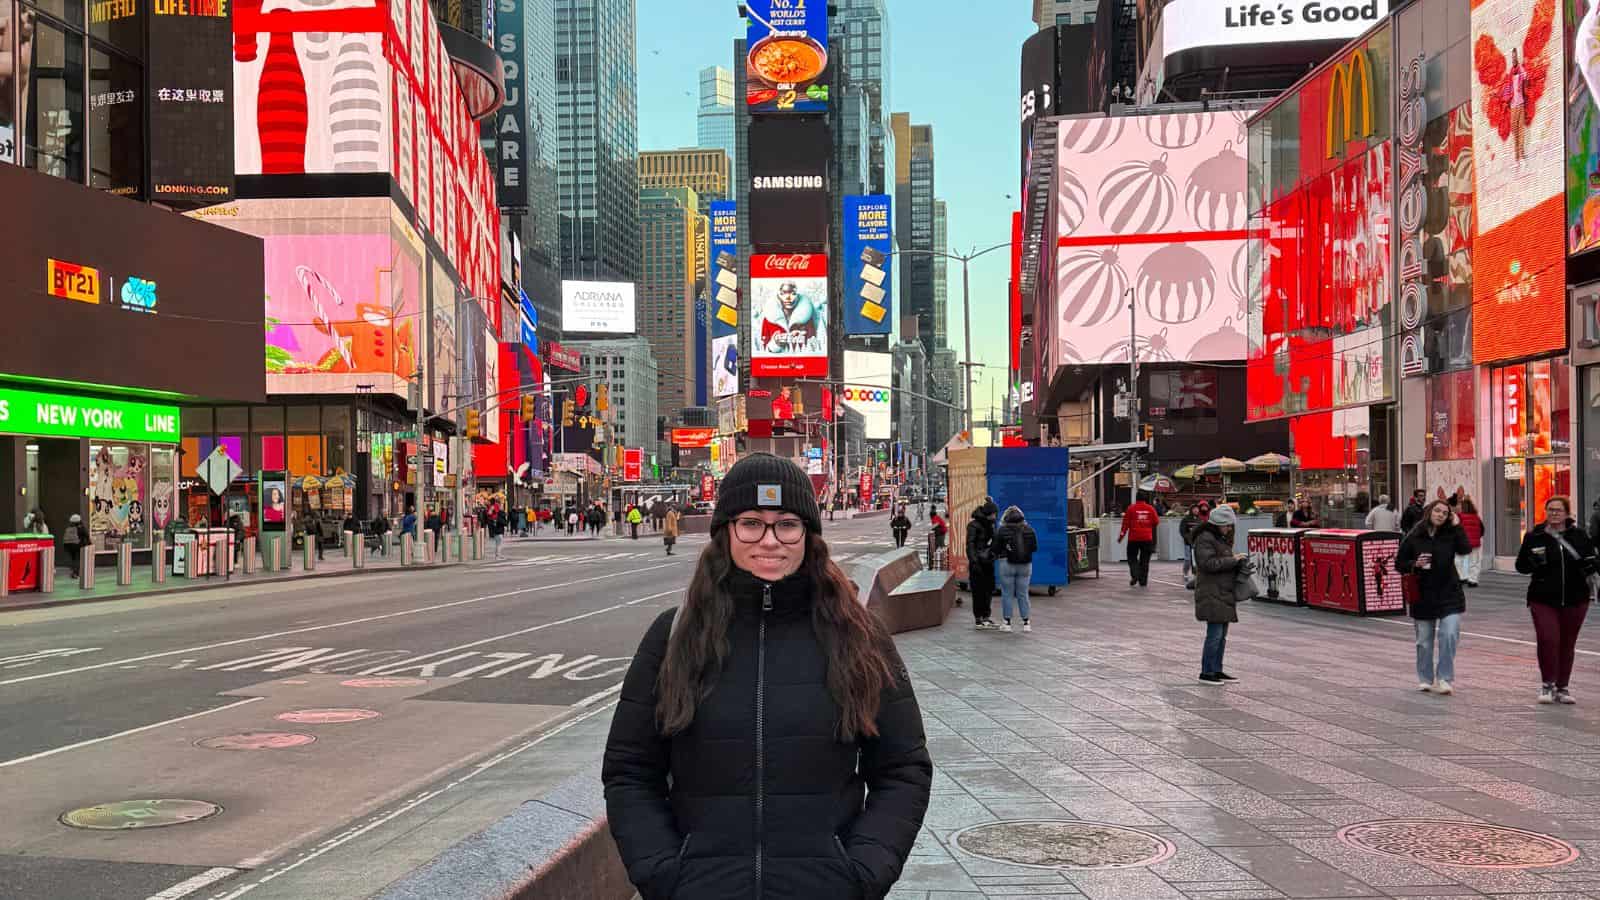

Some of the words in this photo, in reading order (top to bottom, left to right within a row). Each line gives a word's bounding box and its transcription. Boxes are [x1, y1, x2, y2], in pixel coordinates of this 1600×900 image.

[1225, 4, 1294, 28] Life's
[1302, 0, 1378, 23] Good
[777, 83, 796, 91] ONLY
[777, 91, 796, 110] $2
[500, 33, 520, 188] SQUARE
[155, 184, 229, 195] LIONKING.COM
[753, 175, 823, 189] SAMSUNG
[714, 216, 736, 225] MOR
[859, 211, 887, 220] MORE
[53, 268, 95, 296] BT21
[36, 402, 77, 426] NEW
[81, 408, 123, 429] YORK
[144, 412, 175, 433] LINE
[1248, 535, 1295, 555] CHICAGO
